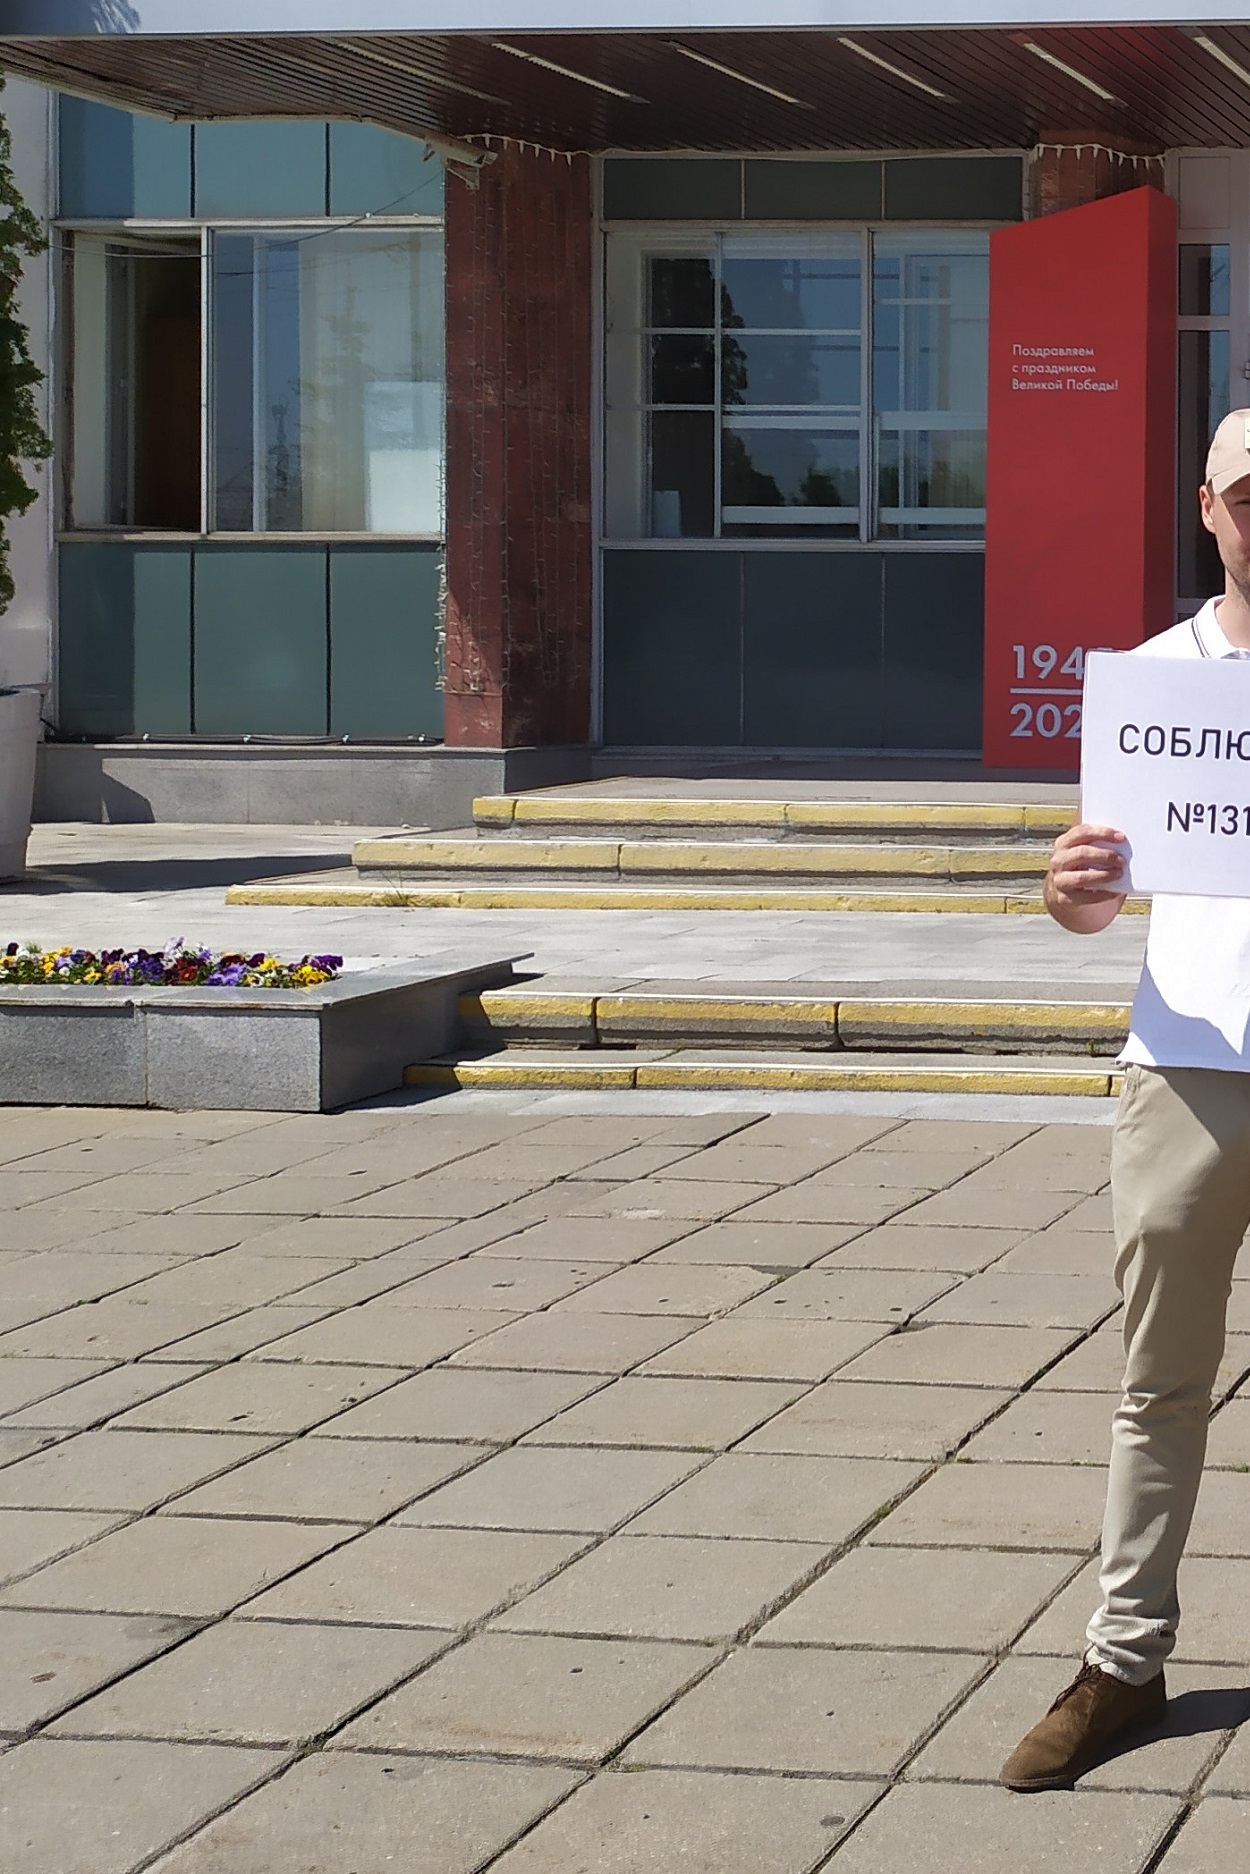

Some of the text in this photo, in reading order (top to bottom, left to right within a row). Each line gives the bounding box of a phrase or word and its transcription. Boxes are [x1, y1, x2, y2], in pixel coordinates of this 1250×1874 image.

[1012, 343, 1095, 358] Поздравляем
[1012, 364, 1097, 376] с праздником
[1012, 378, 1119, 392] Великой Победы!
[1012, 644, 1084, 680] 194
[1010, 702, 1082, 738] 202
